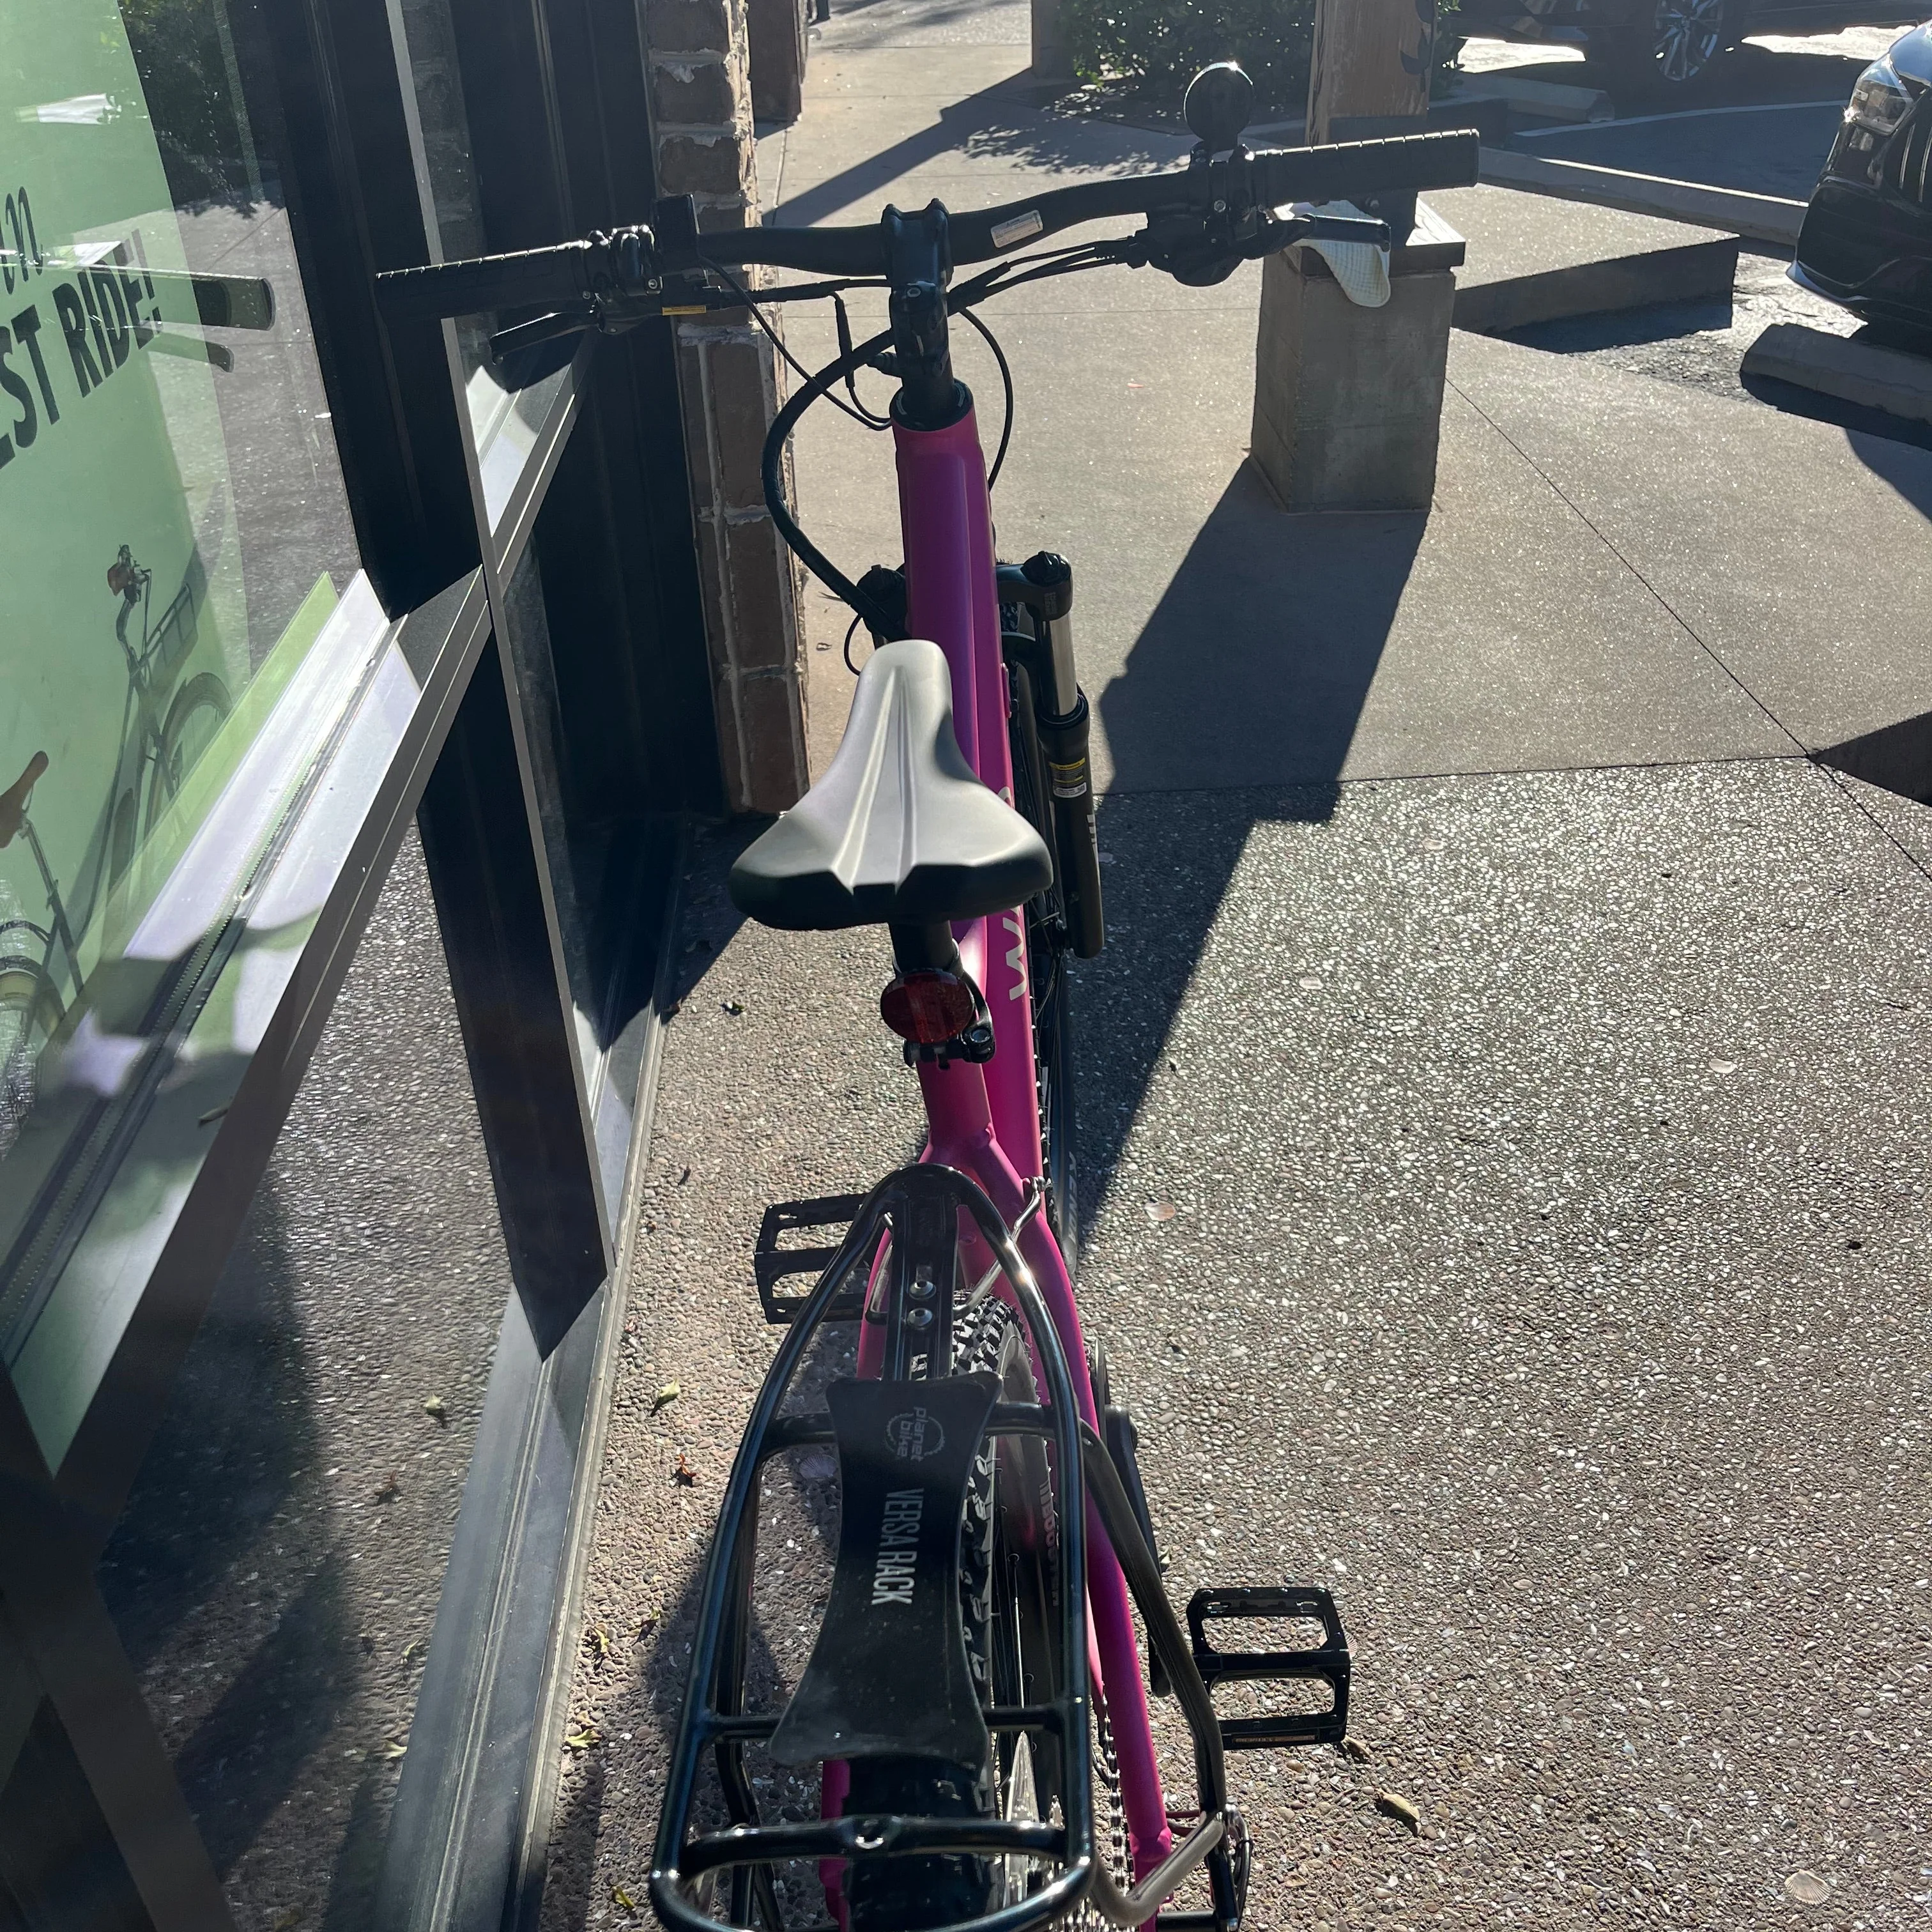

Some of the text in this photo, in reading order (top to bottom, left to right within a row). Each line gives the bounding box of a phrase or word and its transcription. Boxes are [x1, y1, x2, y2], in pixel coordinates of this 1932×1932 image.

[0, 228, 163, 470] ST RIDE!
[896, 1420, 914, 1457] bike
[910, 1406, 928, 1462] planet
[871, 1488, 924, 1606] VERSA RACK
